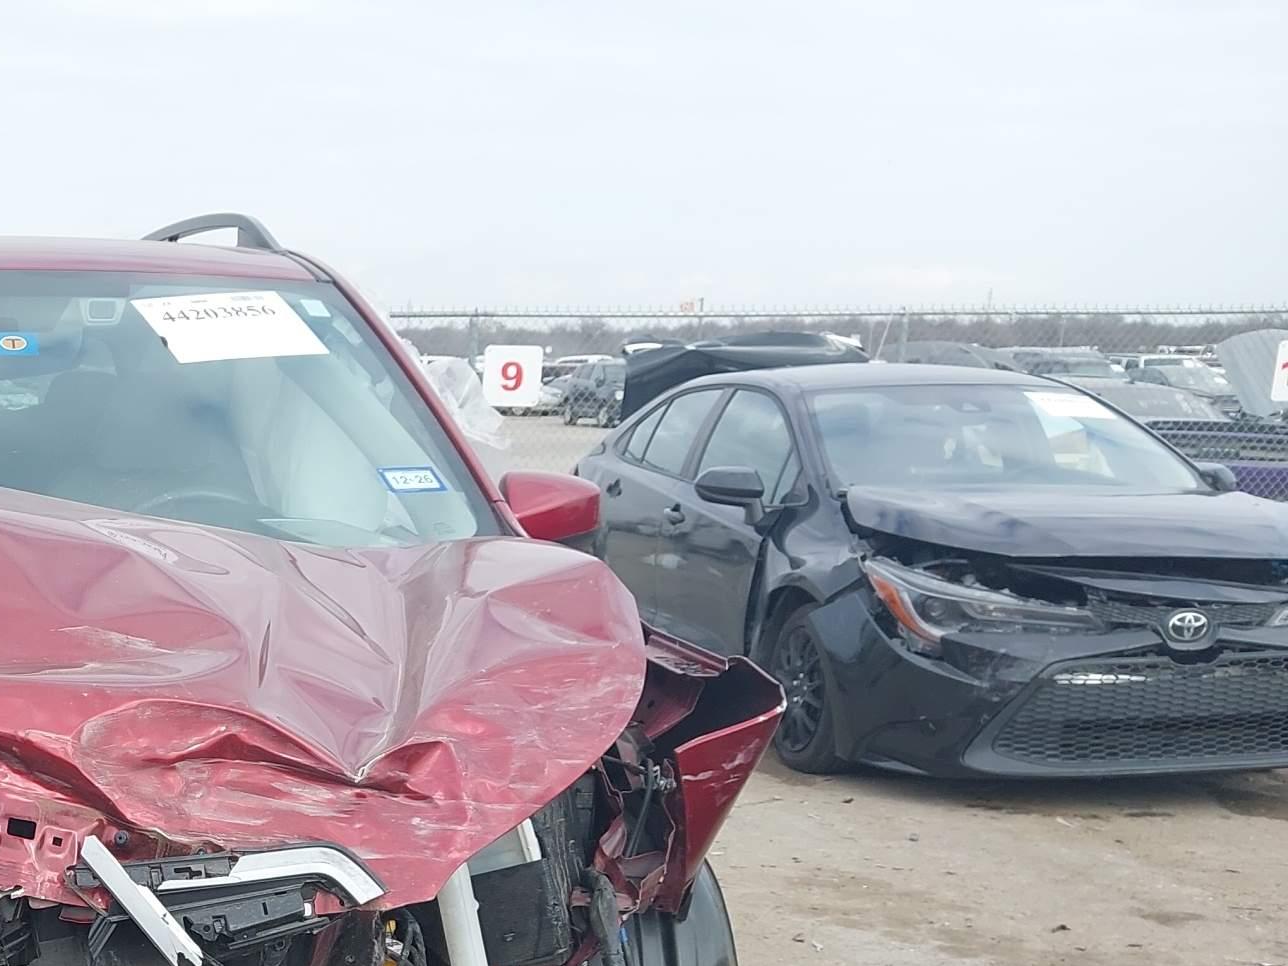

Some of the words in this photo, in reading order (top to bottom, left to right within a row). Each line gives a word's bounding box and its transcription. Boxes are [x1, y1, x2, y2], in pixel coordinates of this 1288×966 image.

[162, 305, 276, 322] 44203856
[501, 361, 523, 391] 9
[392, 474, 433, 485] 12-26
